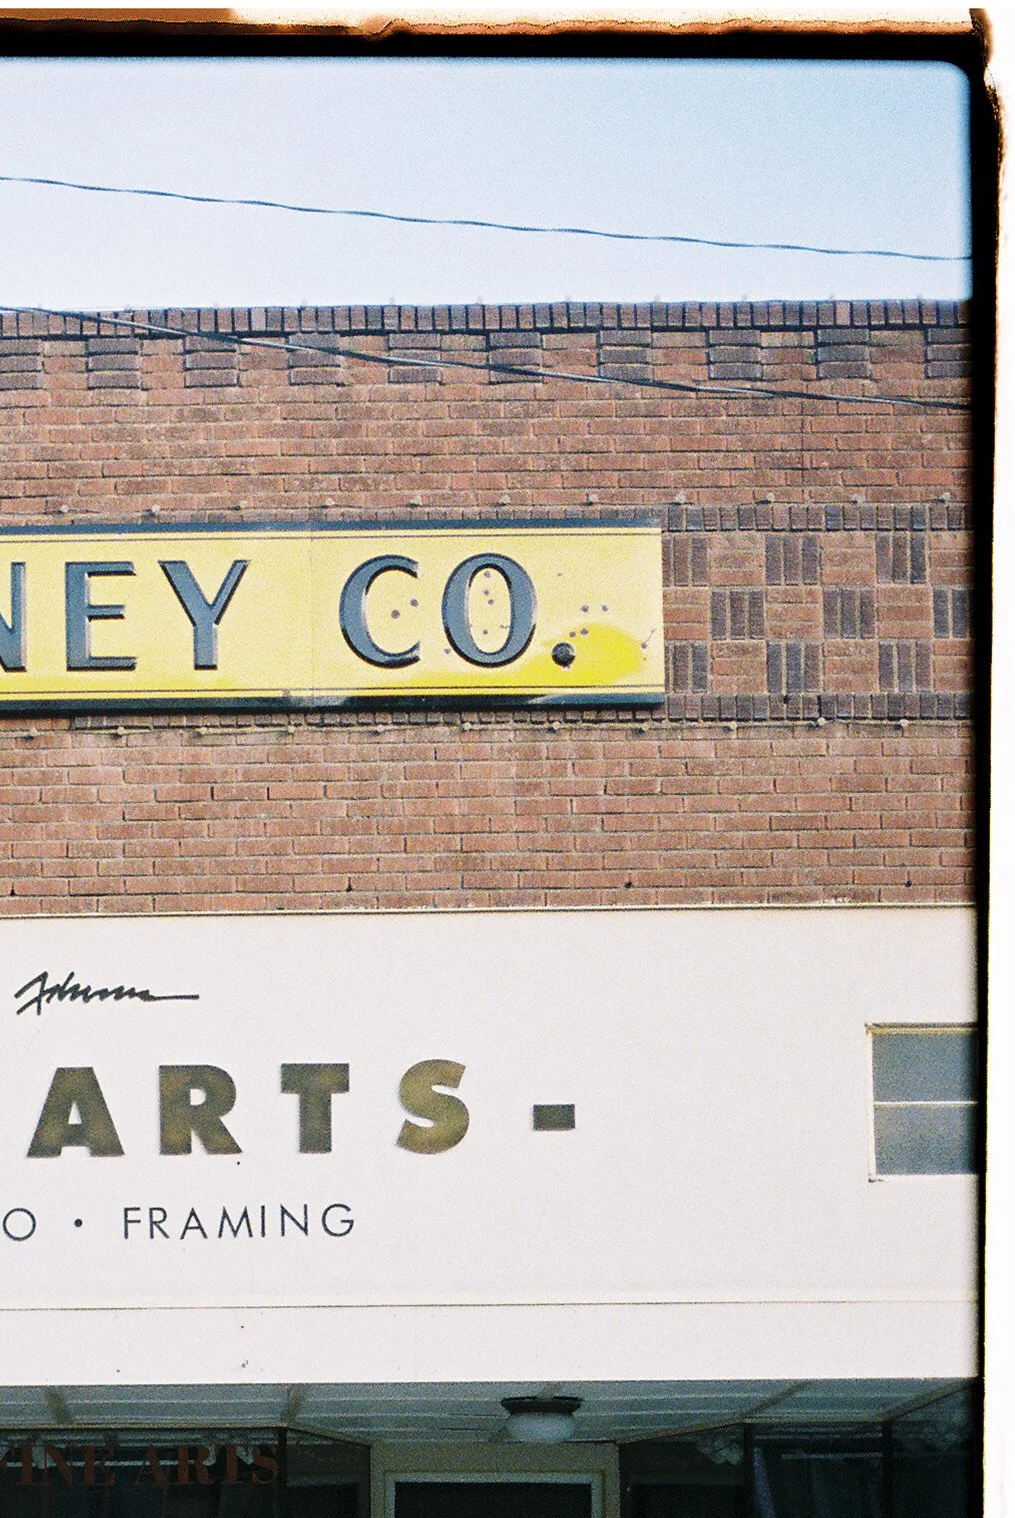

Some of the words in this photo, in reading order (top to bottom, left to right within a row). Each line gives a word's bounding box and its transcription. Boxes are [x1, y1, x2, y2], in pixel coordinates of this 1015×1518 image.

[338, 552, 577, 671] CO.
[26, 1059, 470, 1159] ARTS
[123, 1203, 354, 1240] FRAMING
[134, 1444, 280, 1488] ARTS
